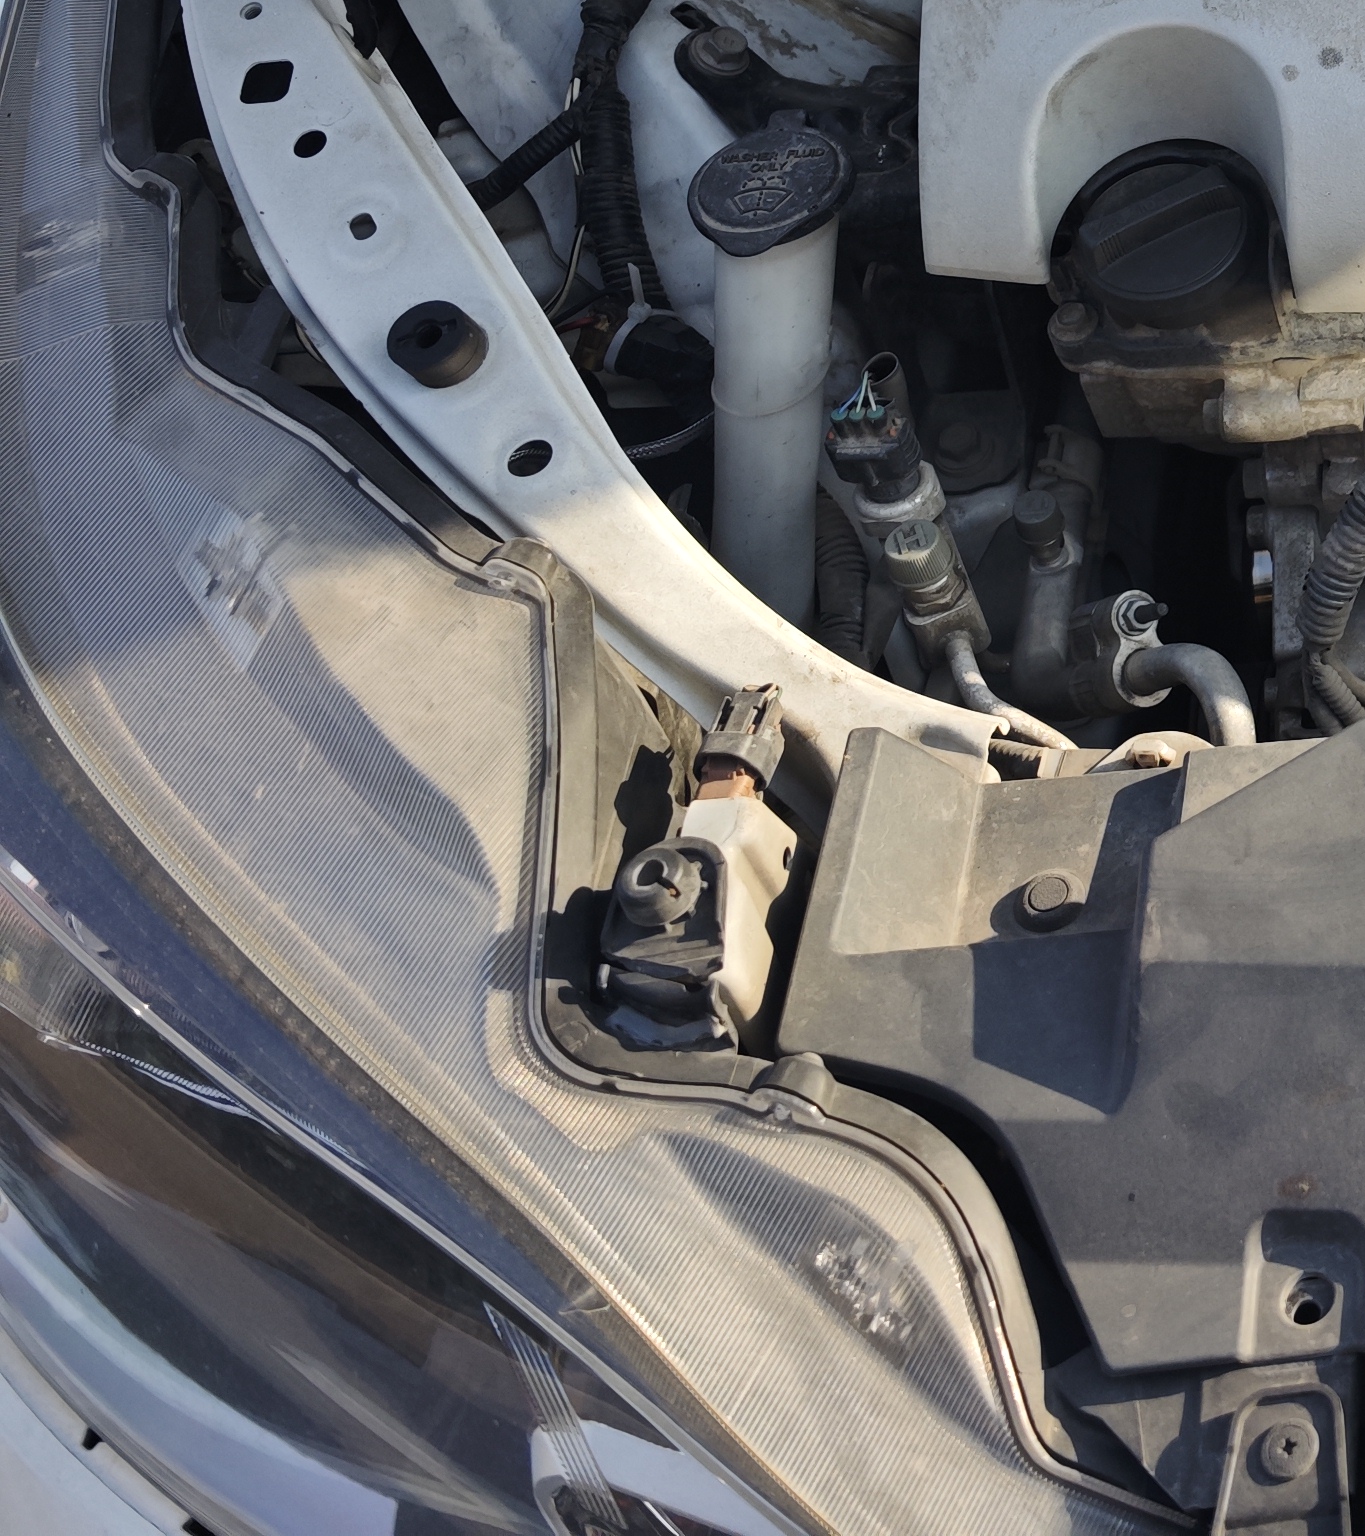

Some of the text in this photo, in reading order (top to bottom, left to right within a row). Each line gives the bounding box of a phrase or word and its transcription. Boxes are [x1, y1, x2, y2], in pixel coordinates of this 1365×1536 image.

[721, 148, 826, 165] WASHER FLUID
[750, 161, 788, 173] ONLY
[895, 521, 930, 553] H
